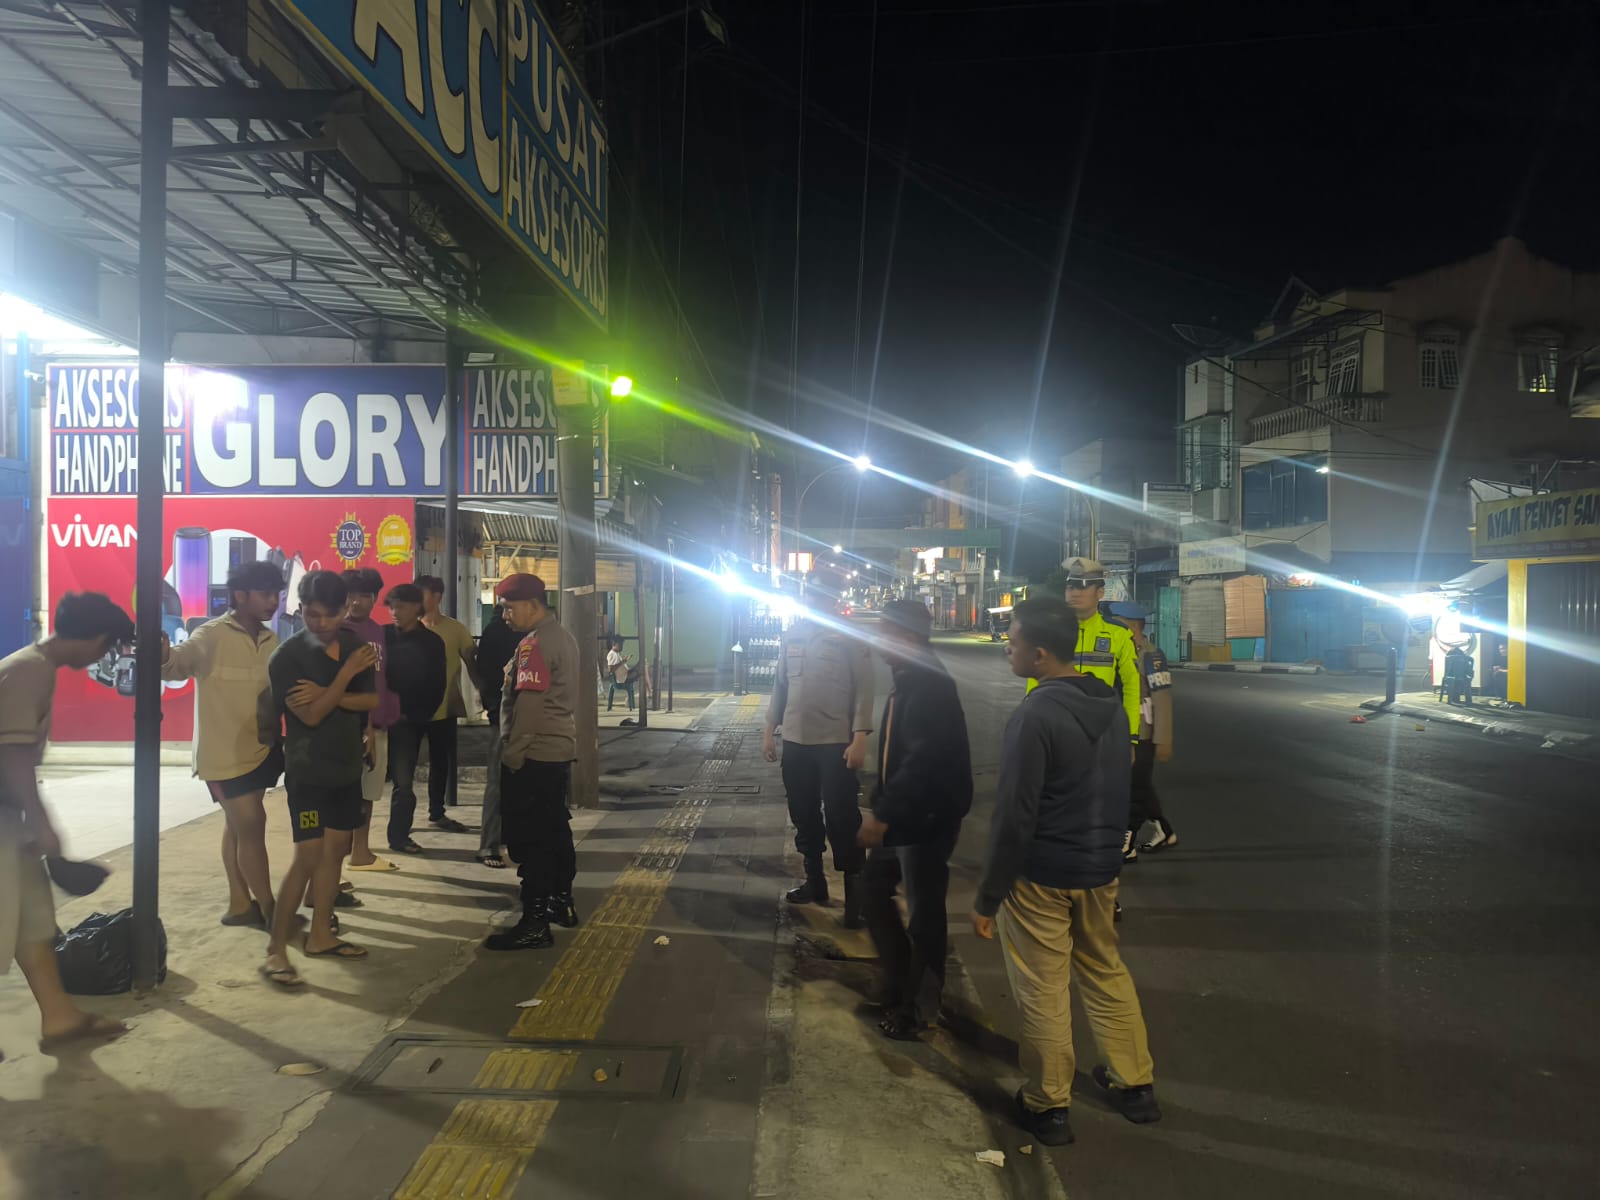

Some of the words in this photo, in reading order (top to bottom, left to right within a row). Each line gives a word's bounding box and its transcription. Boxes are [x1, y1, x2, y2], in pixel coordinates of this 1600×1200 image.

[506, 0, 606, 210] PUSAT
[506, 118, 607, 316] AKSESORIS
[193, 371, 459, 488] GLORY
[339, 529, 361, 541] TOP
[339, 541, 361, 549] BRAND
